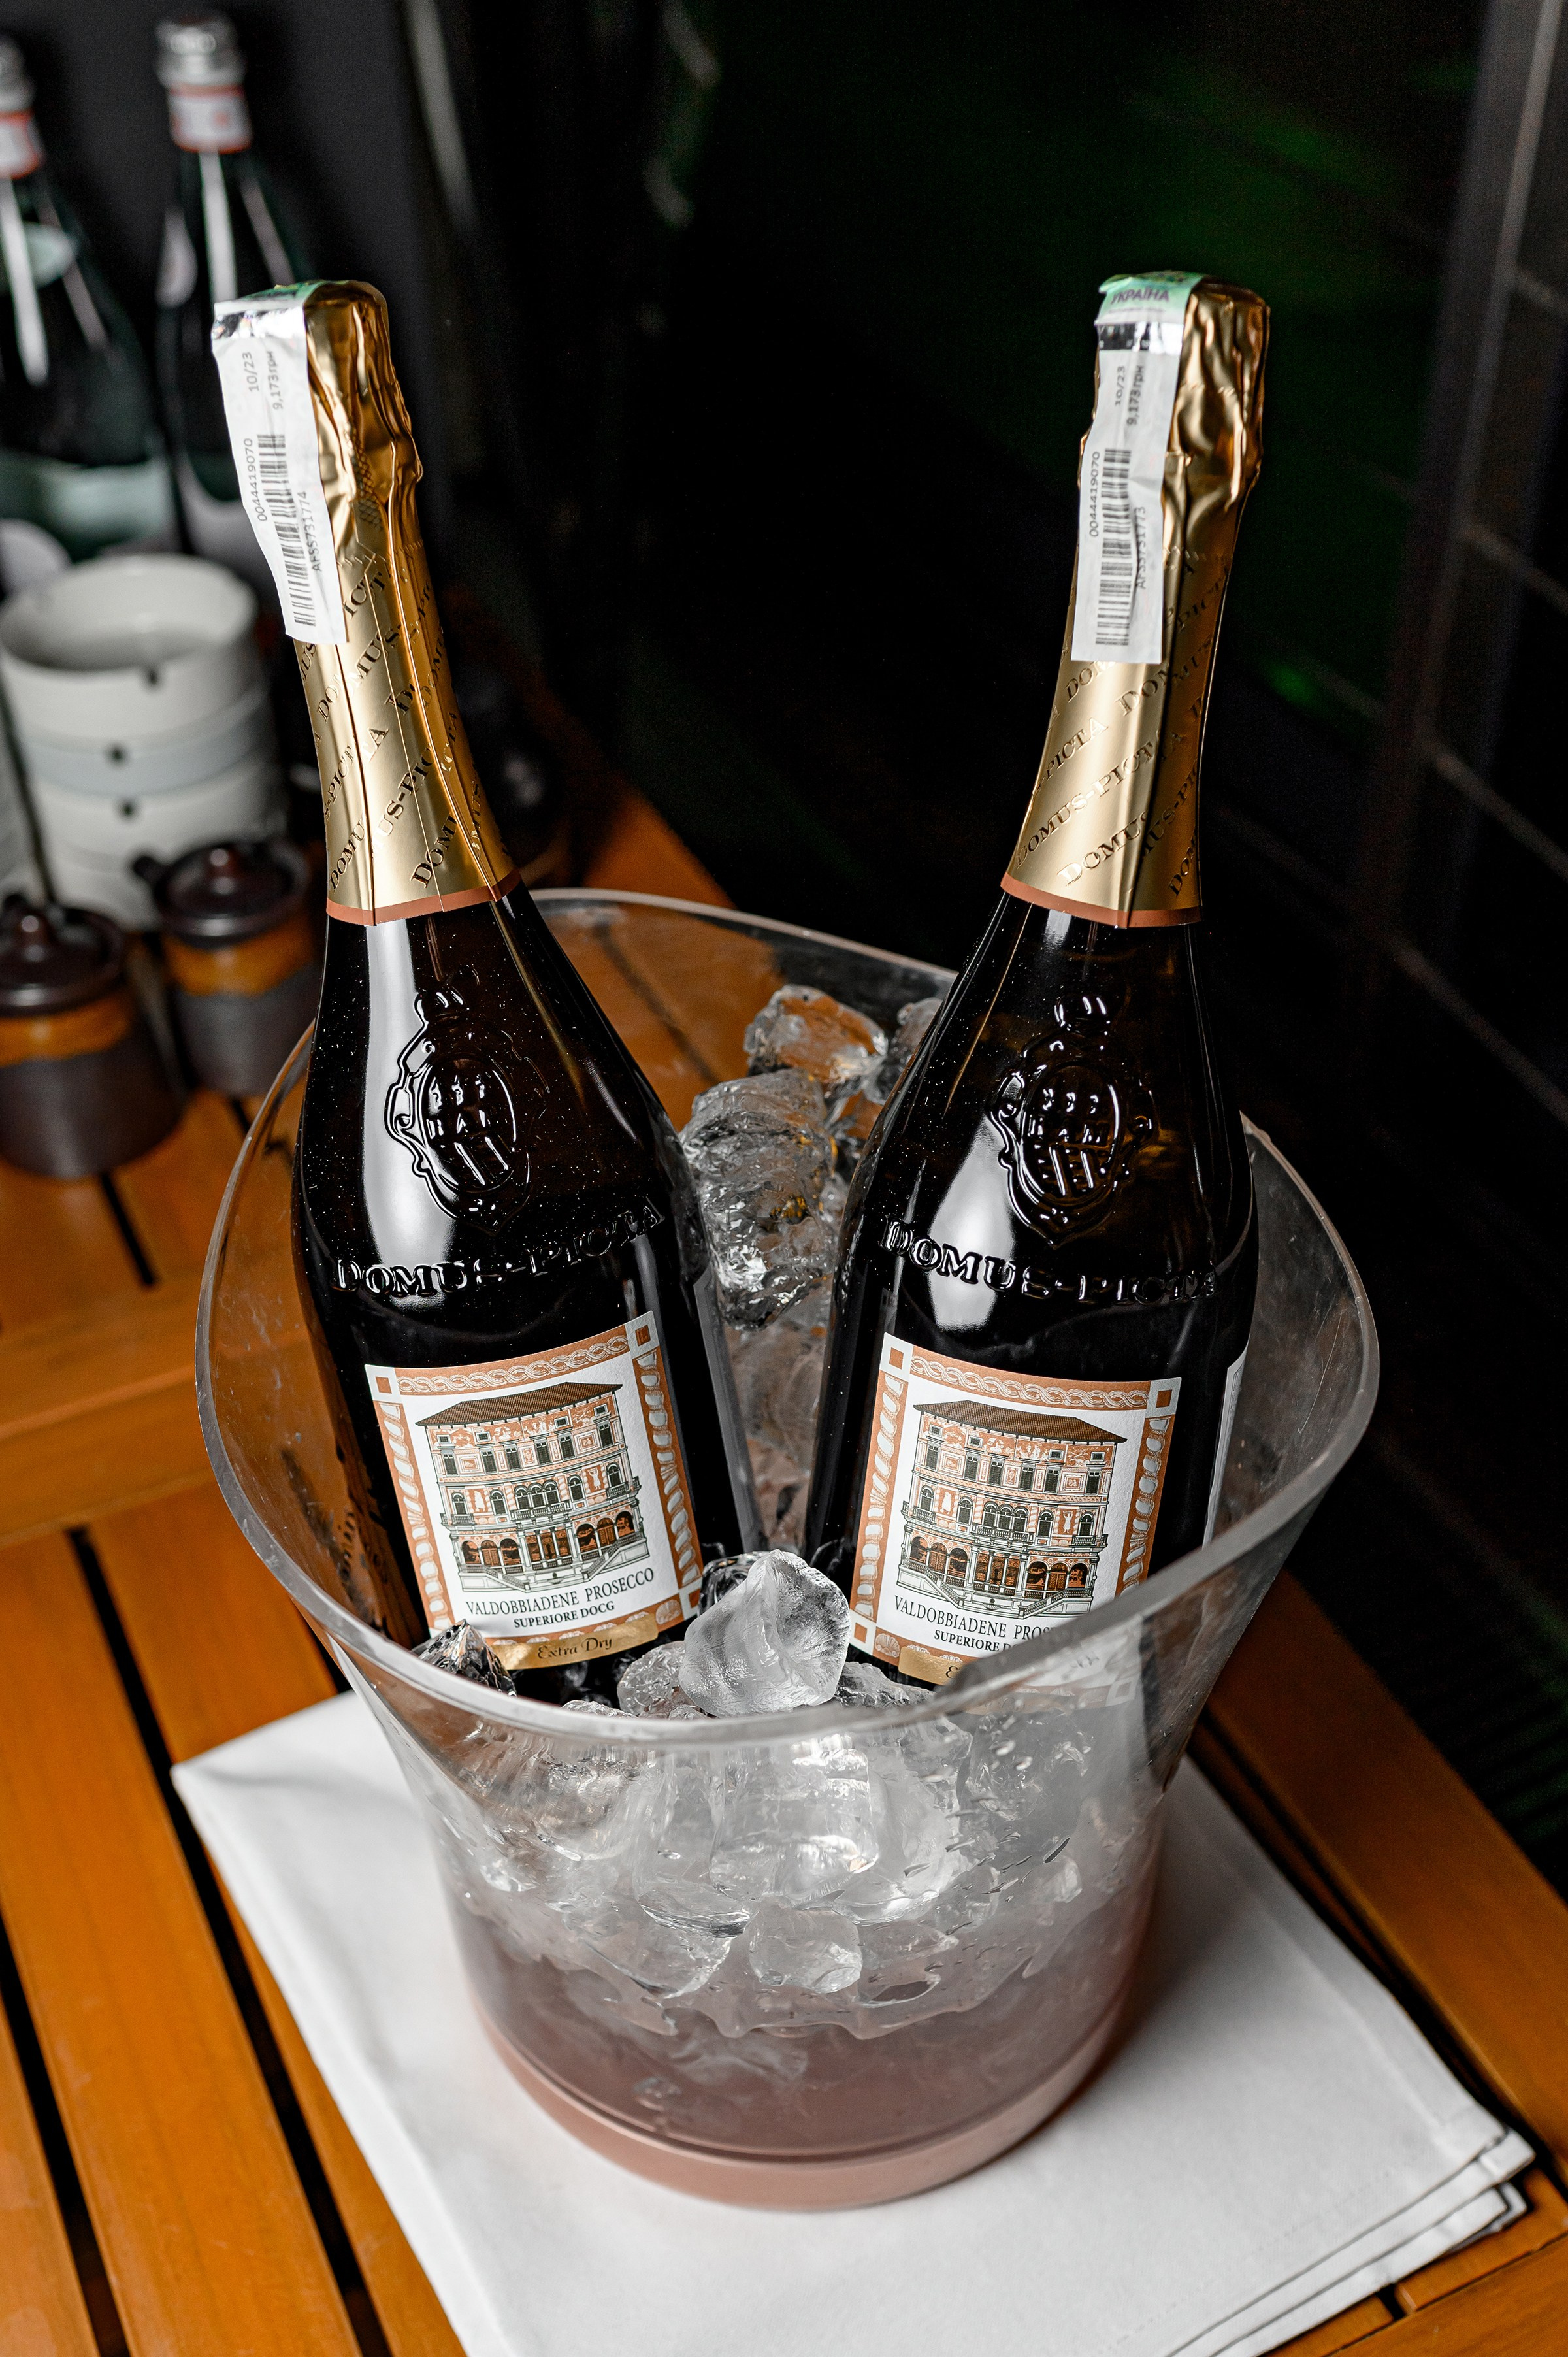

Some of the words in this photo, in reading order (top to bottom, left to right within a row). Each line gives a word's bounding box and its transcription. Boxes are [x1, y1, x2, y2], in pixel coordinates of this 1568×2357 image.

[1111, 287, 1169, 305] УКРАЇНА
[242, 351, 259, 392] 10/23
[1115, 365, 1125, 406] 10/23
[243, 438, 267, 521] 0044419070
[1089, 451, 1100, 537] 0044419070
[1017, 727, 1162, 870] DOMUS-PICT
[466, 1591, 580, 1616] VALDOBBIADENE
[585, 1567, 654, 1602] PROSECCO
[514, 1613, 578, 1628] SUPERIORE
[581, 1601, 615, 1619] DOCG
[894, 1595, 1007, 1639] VALDOBBIADENE
[1013, 1624, 1056, 1640] PROS
[537, 1645, 578, 1660] Extra
[581, 1637, 613, 1653] Dry
[934, 1630, 1000, 1652] SUPERIORE
